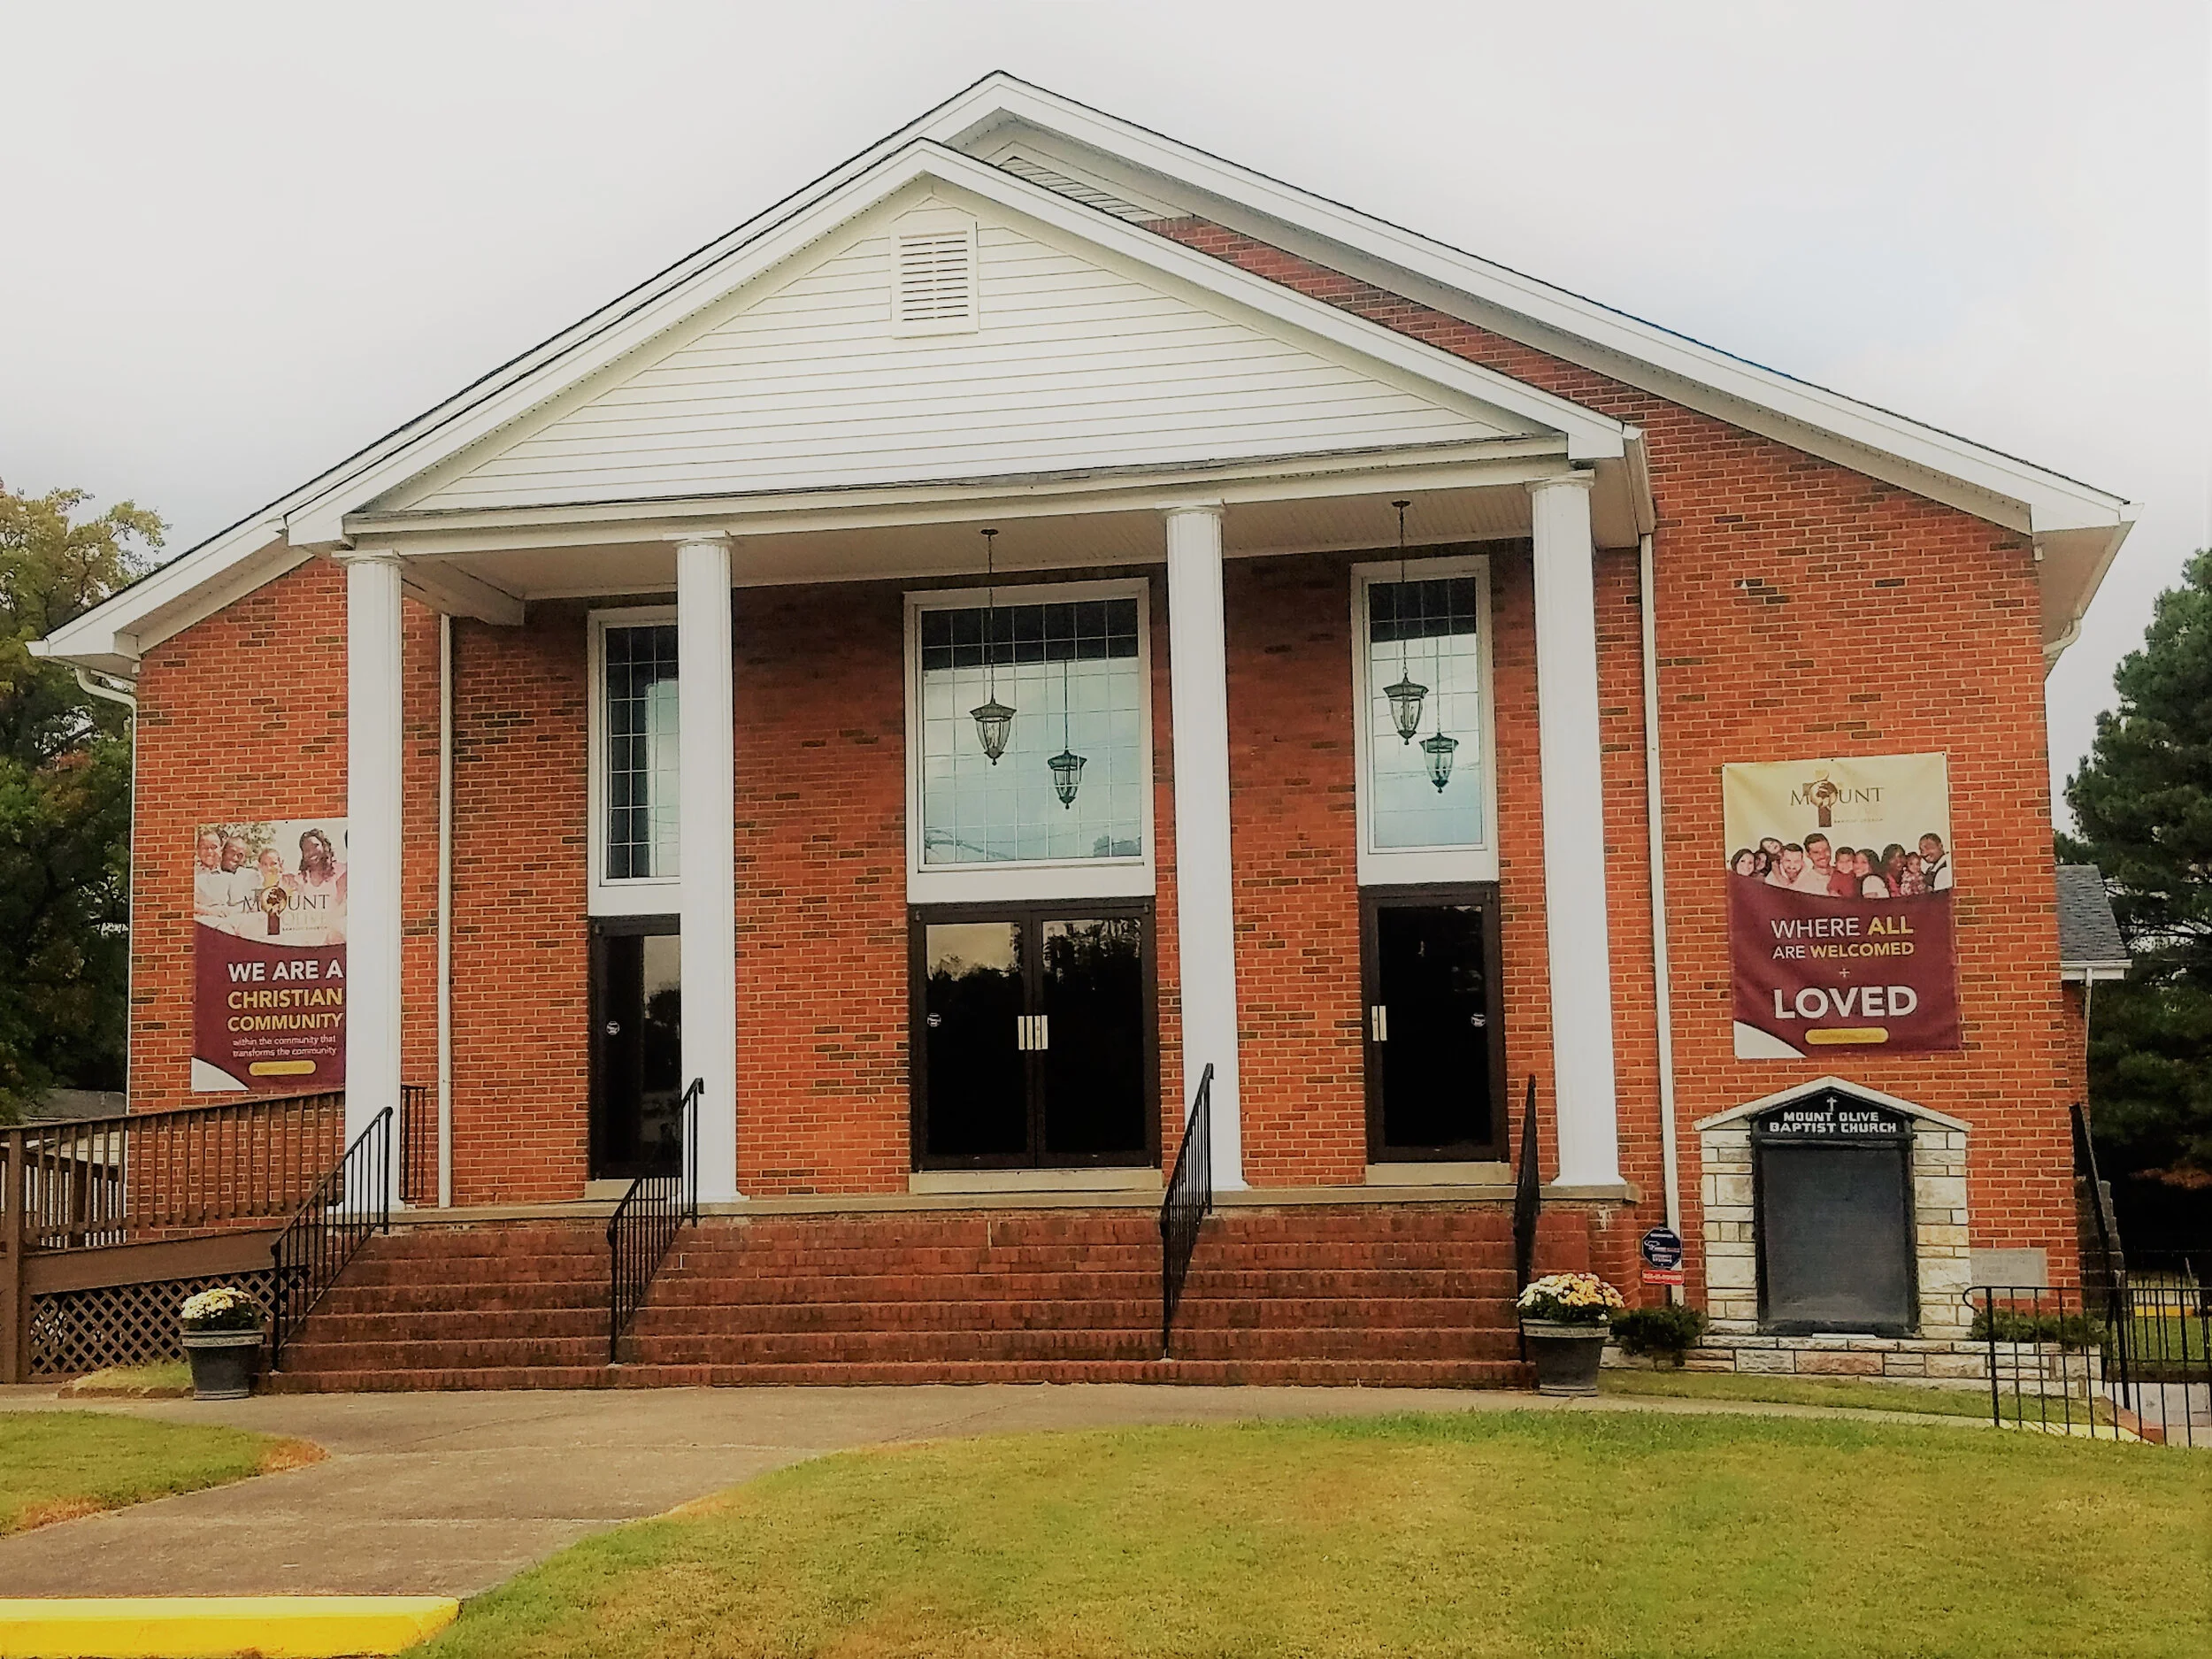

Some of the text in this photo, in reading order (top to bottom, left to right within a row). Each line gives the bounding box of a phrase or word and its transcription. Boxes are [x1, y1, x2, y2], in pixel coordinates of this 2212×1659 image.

[1770, 915, 1914, 939] WHERE ALL
[1771, 941, 1915, 959] ARE WELCOMED
[227, 958, 343, 982] WE ARE A
[227, 987, 343, 1010] CHRISTIAN
[1773, 985, 1918, 1019] LOVED
[227, 1012, 343, 1032] COMMUNITY
[233, 1034, 336, 1046] within the community that
[233, 1046, 337, 1057] transforms the community
[1783, 1111, 1879, 1122] MOUNT OLIVE
[1770, 1122, 1897, 1133] BAPTIST CHURCH
